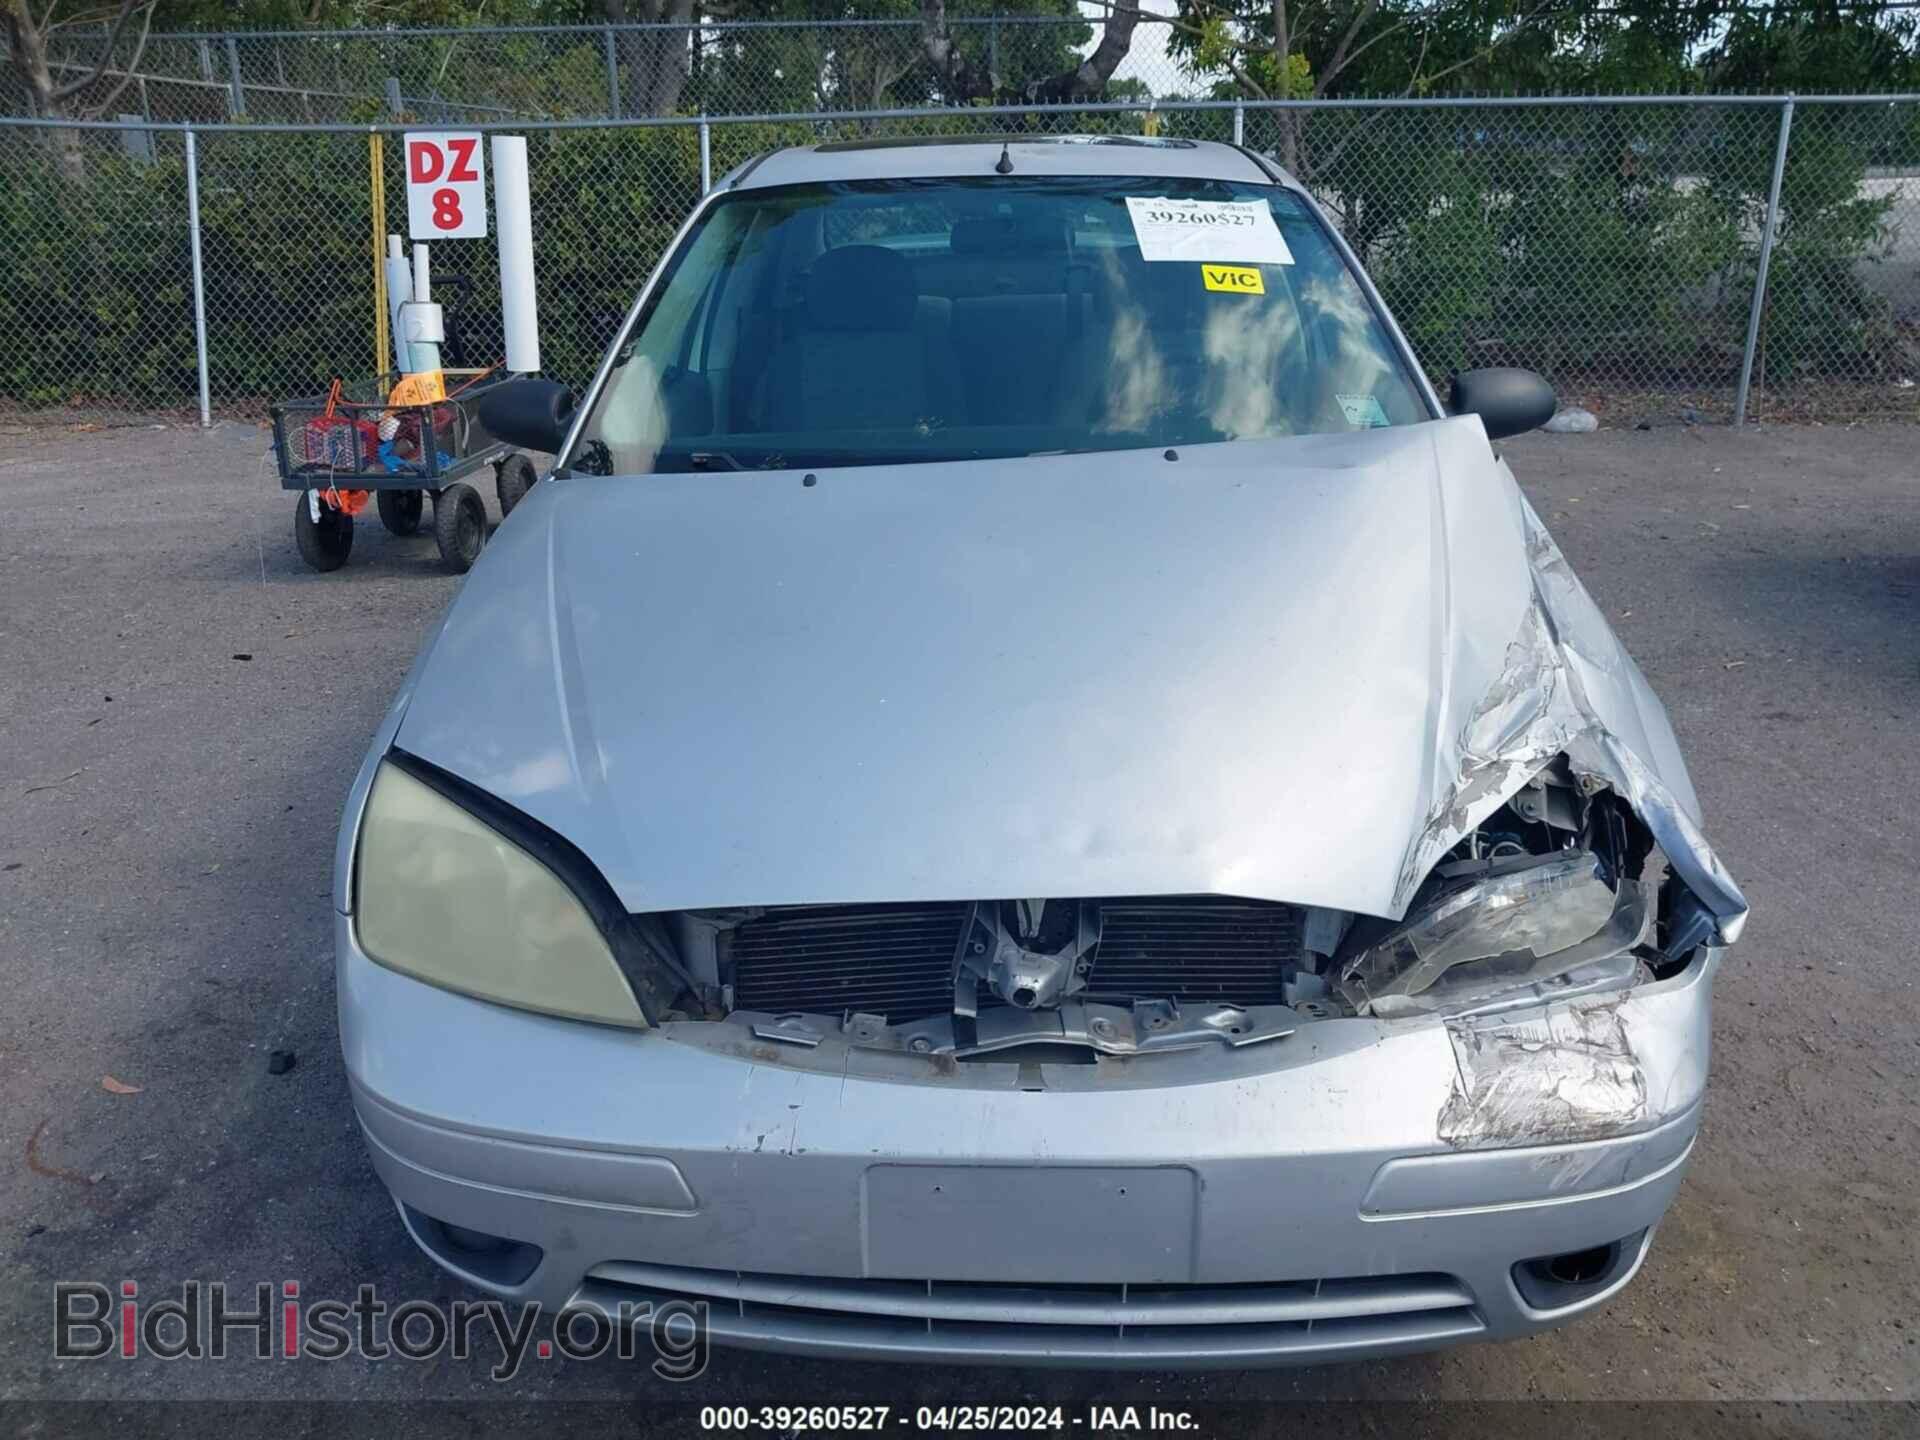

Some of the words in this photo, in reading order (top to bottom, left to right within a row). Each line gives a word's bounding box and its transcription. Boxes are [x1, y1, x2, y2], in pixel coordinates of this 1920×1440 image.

[409, 139, 479, 184] DZ
[432, 188, 463, 230] 8
[1146, 210, 1255, 226] 39260527
